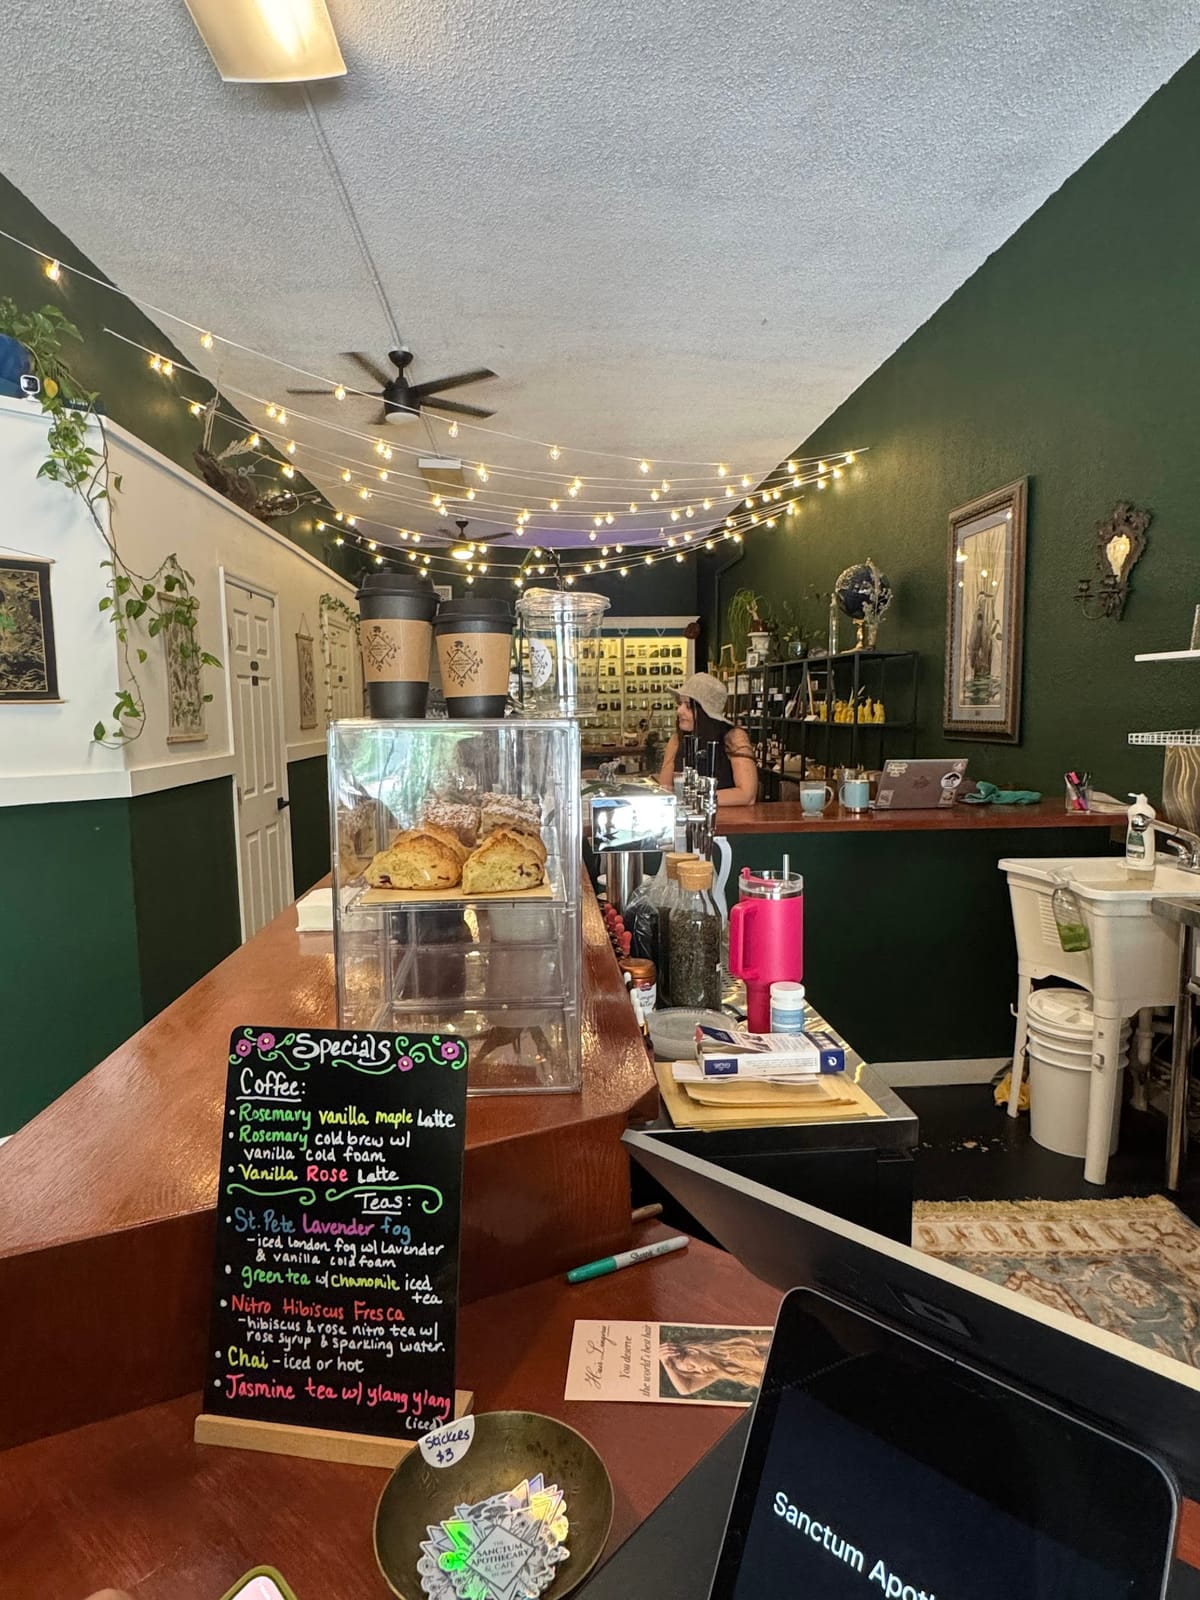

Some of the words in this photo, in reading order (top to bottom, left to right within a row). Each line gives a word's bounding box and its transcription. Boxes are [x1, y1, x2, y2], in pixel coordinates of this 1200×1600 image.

[292, 1033, 391, 1065] Specials
[240, 1067, 306, 1096] Coffee:
[239, 1103, 311, 1130] Rosemary
[319, 1105, 369, 1125] vanilla
[375, 1108, 413, 1129] maple
[417, 1108, 456, 1127] Latte
[239, 1126, 308, 1150] Rosemary
[315, 1130, 344, 1146] cold
[347, 1131, 383, 1146] brew
[389, 1131, 411, 1148] w/
[244, 1146, 295, 1161] vanilla
[305, 1148, 336, 1162] cold
[343, 1148, 386, 1162] foam
[238, 1163, 298, 1181] Vanilla
[306, 1165, 348, 1182] Rose
[357, 1168, 399, 1183] Latte
[354, 1193, 412, 1210] Teas:
[234, 1207, 261, 1233] St.
[264, 1211, 296, 1234] Pete
[379, 1216, 411, 1245] fog
[334, 1239, 357, 1256] fog
[361, 1242, 378, 1254] w/
[255, 1248, 266, 1263] &
[273, 1252, 321, 1265] vanilla
[330, 1253, 356, 1268] cold
[358, 1255, 397, 1269] foam
[241, 1268, 284, 1289] green
[285, 1268, 311, 1285] tea
[315, 1274, 329, 1288] w/
[404, 1273, 433, 1291] iced
[231, 1295, 272, 1314] Nitro
[283, 1299, 345, 1320] Hibiscus
[353, 1301, 405, 1322] Fresca
[411, 1293, 443, 1305] tea
[317, 1325, 347, 1335] rose
[352, 1321, 385, 1336] nitro
[389, 1323, 417, 1337] tea
[419, 1322, 438, 1341] w/
[641, 1324, 653, 1338] hair
[246, 1331, 274, 1343] rose
[278, 1335, 312, 1352] syrup
[332, 1335, 393, 1358] sparkling
[400, 1341, 446, 1352] water.
[621, 1336, 633, 1363] deserve
[641, 1338, 652, 1354] best
[227, 1346, 269, 1369] Chai
[316, 1359, 333, 1372] or
[337, 1358, 365, 1373] hot
[640, 1354, 652, 1382] world's
[620, 1363, 631, 1379] You
[226, 1374, 296, 1400] Jasmine
[304, 1377, 337, 1400] tea
[341, 1381, 362, 1405] w/
[367, 1383, 408, 1414] ylang
[412, 1389, 451, 1420] ylang
[640, 1382, 651, 1398] the
[436, 1449, 455, 1464] $3
[773, 1491, 865, 1572] Sanctum
[472, 1549, 528, 1566] APOTHECARY
[476, 1543, 523, 1557] SANCTUM
